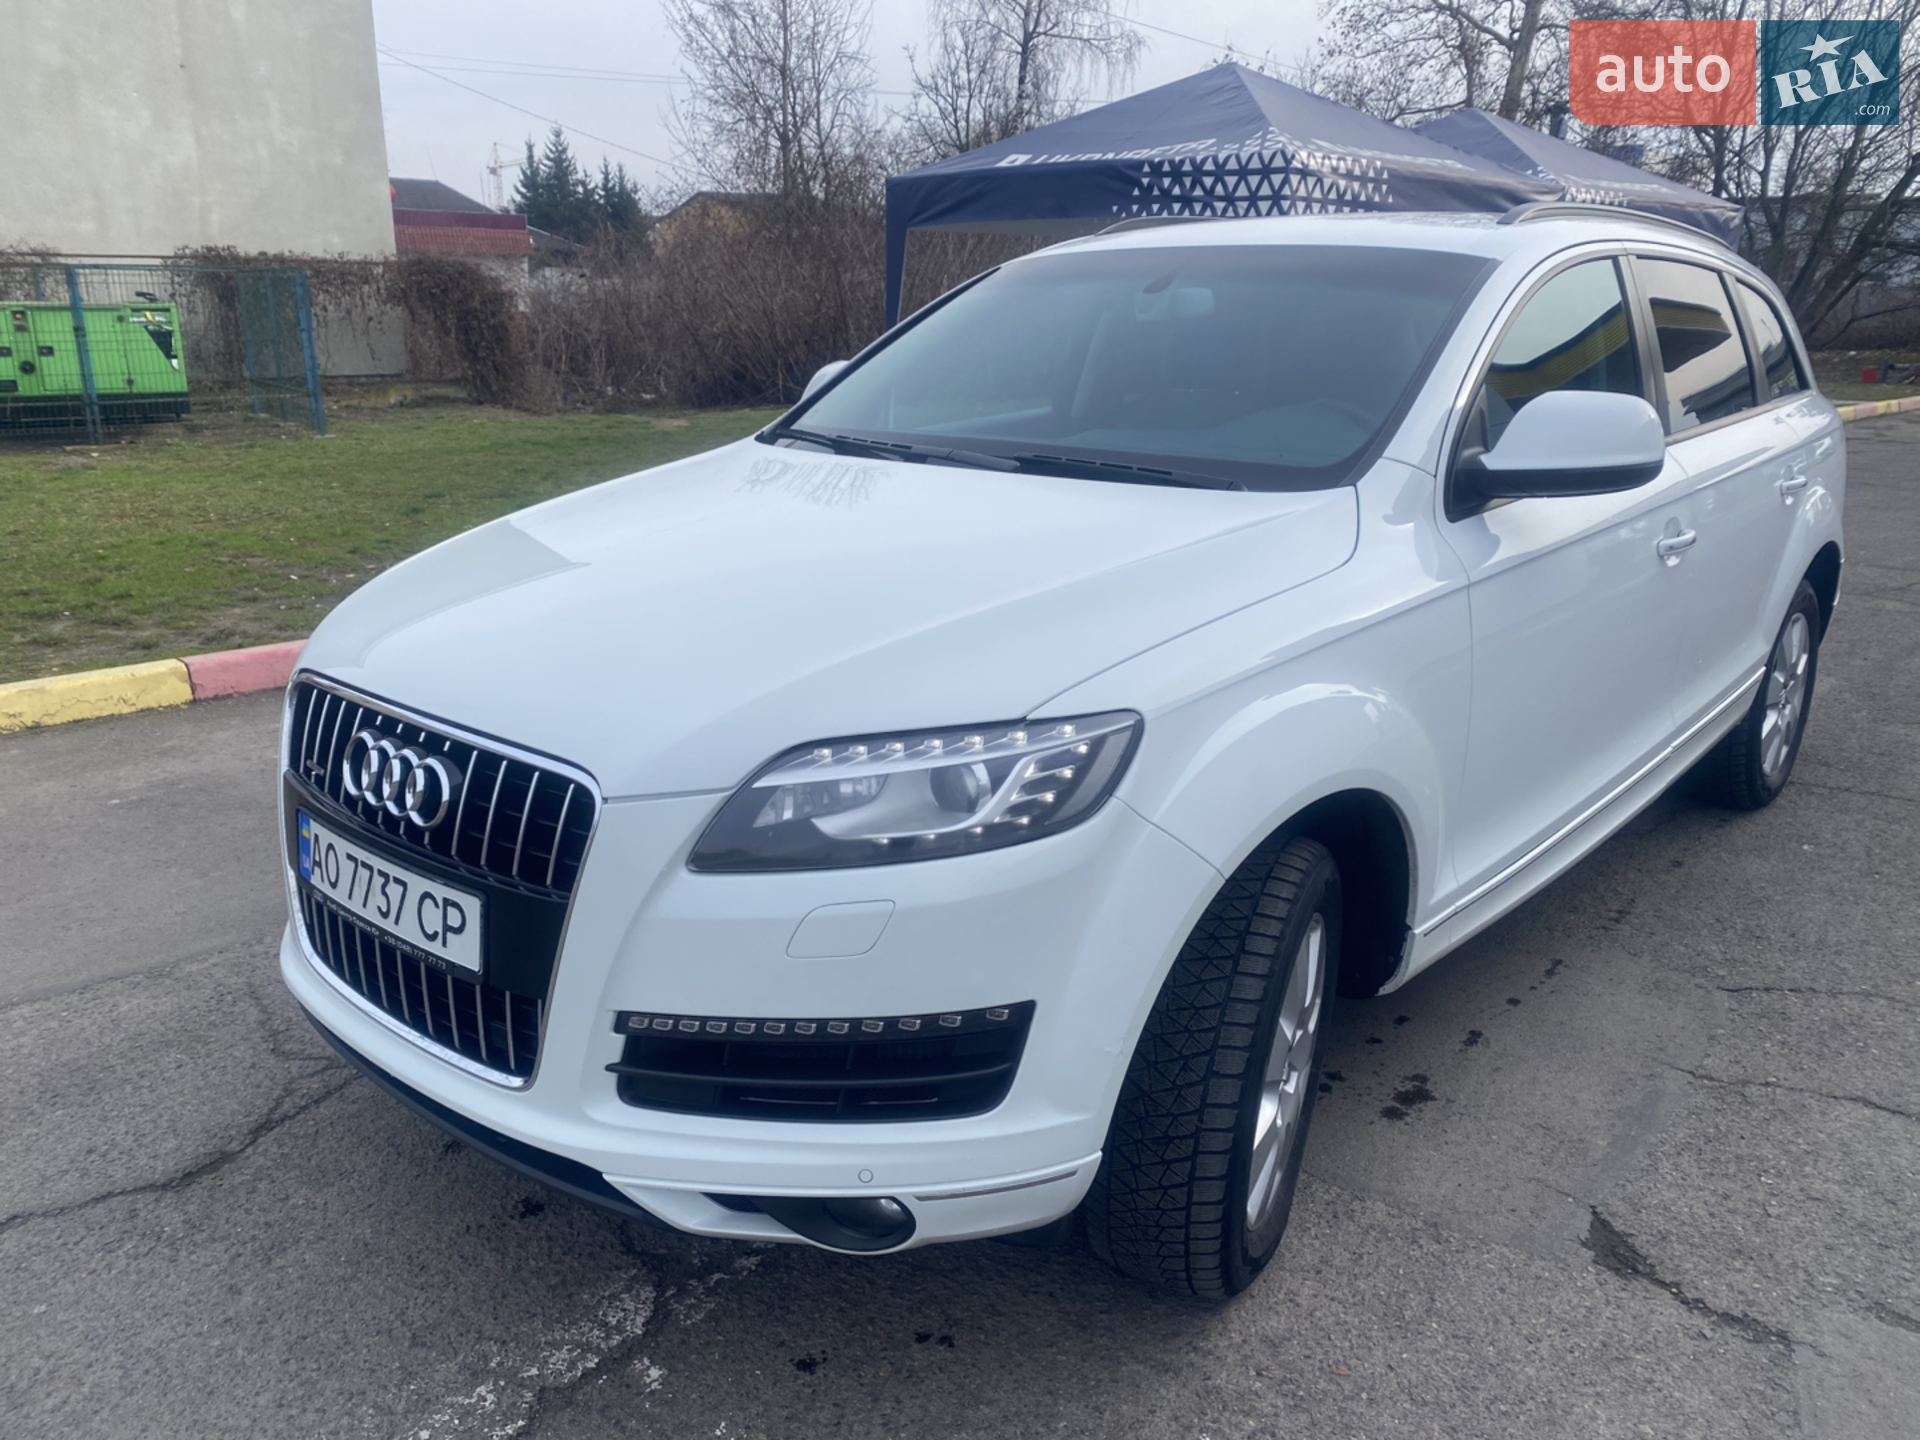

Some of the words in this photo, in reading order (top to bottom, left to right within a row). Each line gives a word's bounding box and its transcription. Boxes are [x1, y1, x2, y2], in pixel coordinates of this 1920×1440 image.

[311, 833, 340, 890] AO
[346, 852, 408, 926] 7737
[417, 890, 467, 949] CP
